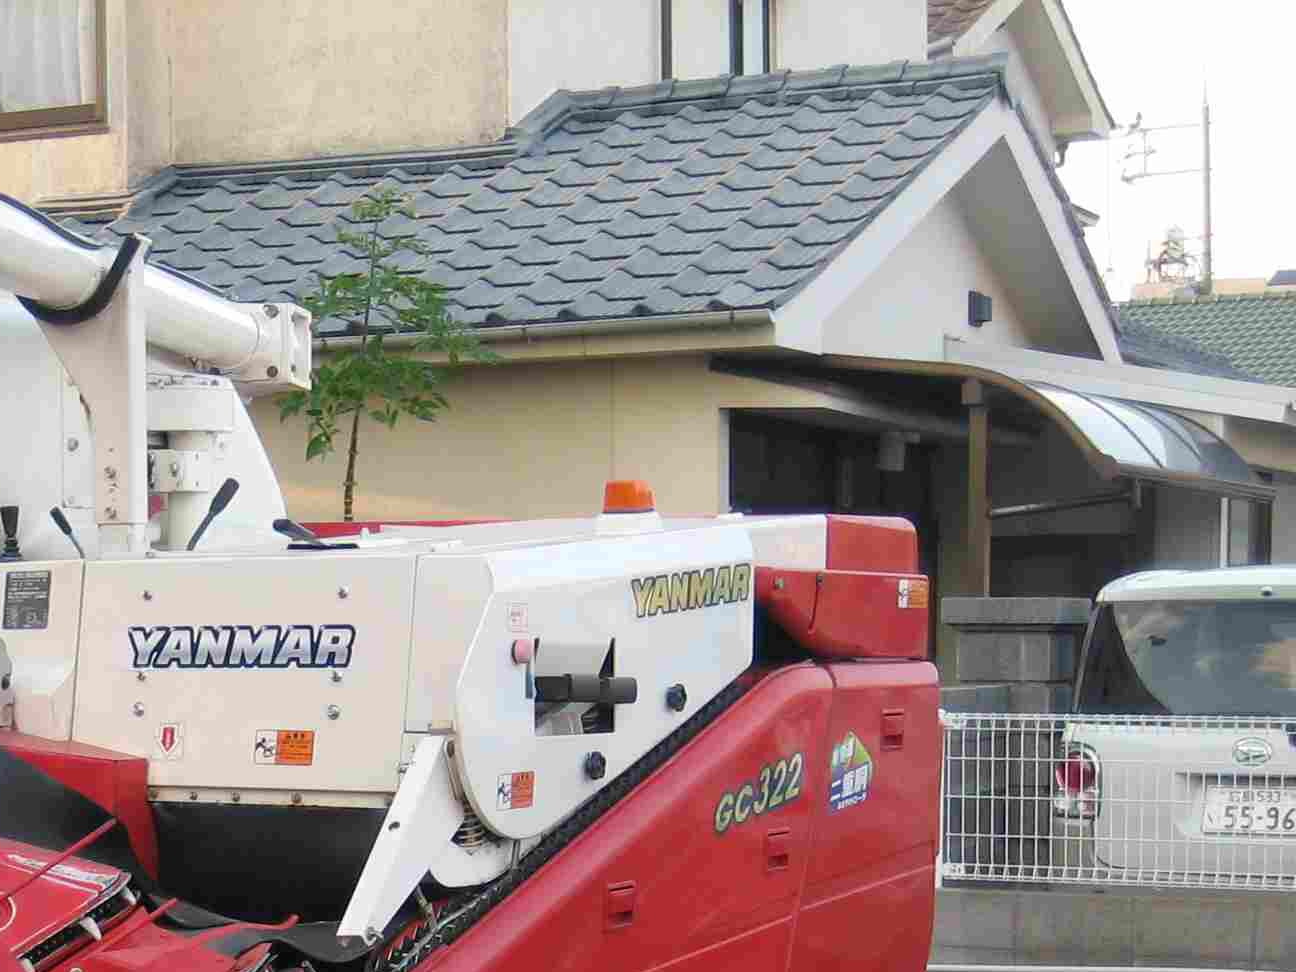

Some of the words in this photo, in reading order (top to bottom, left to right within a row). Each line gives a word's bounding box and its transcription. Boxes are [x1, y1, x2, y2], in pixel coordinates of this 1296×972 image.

[631, 563, 752, 618] YANMAR
[128, 624, 356, 668] YANMAR
[714, 751, 803, 833] GC322
[1223, 805, 1296, 830] 55-96
